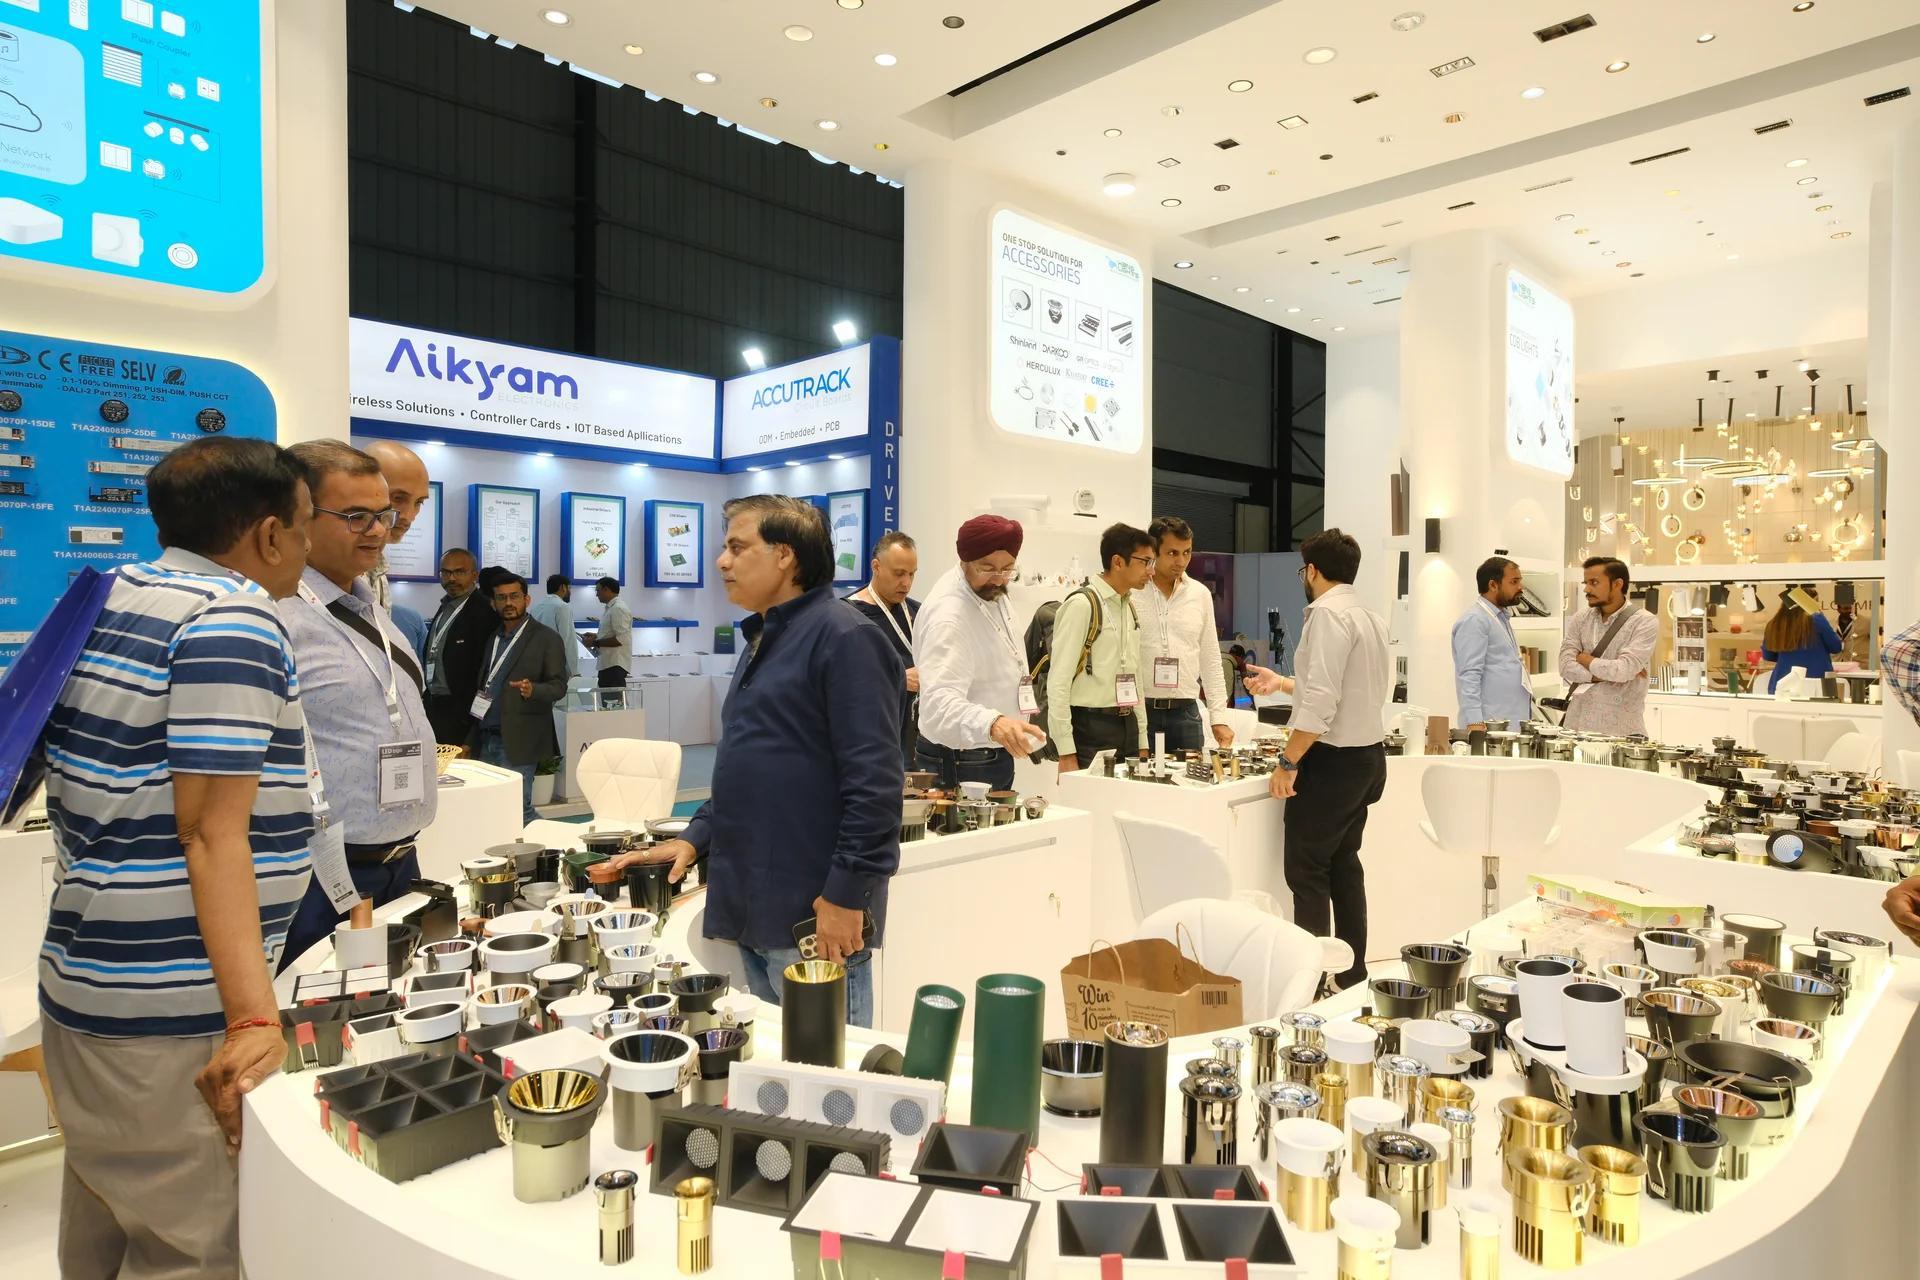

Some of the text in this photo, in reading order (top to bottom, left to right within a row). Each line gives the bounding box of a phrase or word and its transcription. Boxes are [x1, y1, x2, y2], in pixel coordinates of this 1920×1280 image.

[157, 40, 191, 57] Coupler
[0, 141, 52, 161] Network
[1002, 232, 1083, 269] ONE STOP SOLUTION FOR
[1002, 245, 1081, 285] ACCESSORIES
[4, 370, 47, 380] with CLO
[80, 365, 114, 377] FREE
[120, 359, 157, 382] SELV
[385, 338, 579, 400] Aikyam
[1026, 360, 1061, 377] HERCULUX
[94, 389, 111, 397] Part
[189, 390, 212, 399] PUSH
[213, 393, 230, 401] CCT
[752, 366, 852, 411] ACCUTRACK
[395, 400, 455, 418] Solutions
[470, 409, 528, 427] Controller
[530, 417, 562, 431] Cards
[574, 422, 591, 435] IOT
[594, 425, 625, 438] Based
[627, 429, 683, 446] Apllications
[780, 425, 816, 441] Embedded
[825, 420, 841, 433] PCB
[73, 504, 153, 516] T1A2240070P-25F
[1077, 983, 1110, 1006] Win
[1081, 1007, 1098, 1031] 10
